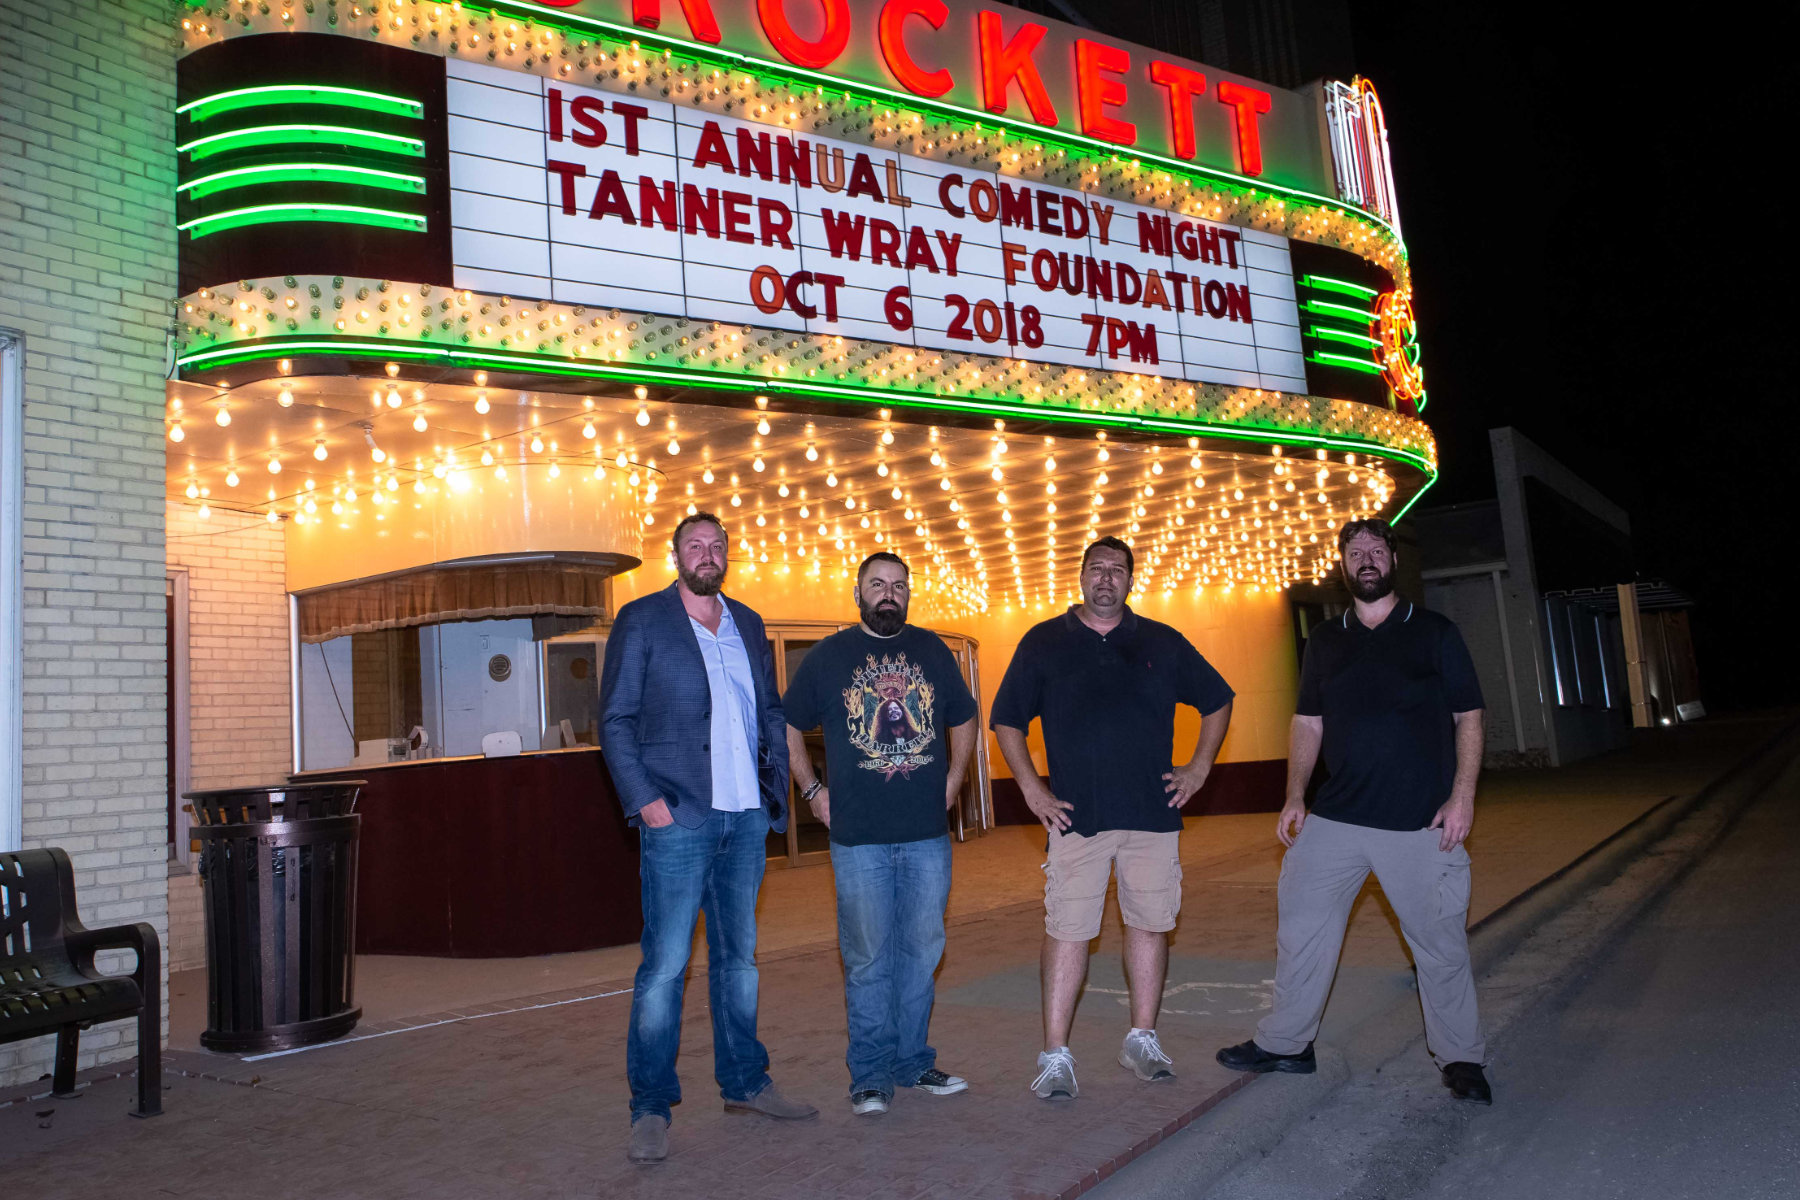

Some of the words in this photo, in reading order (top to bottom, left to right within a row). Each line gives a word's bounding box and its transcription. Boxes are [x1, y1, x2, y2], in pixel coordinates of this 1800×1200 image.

[532, 0, 1273, 177] OCKETT
[547, 159, 795, 250] TANNER
[820, 207, 962, 277] WRAY
[1002, 241, 1253, 325] FOUNDATION
[693, 120, 912, 208] ANNUAL
[938, 173, 1115, 246] COMEDY
[1137, 211, 1241, 270] NIGHT
[749, 264, 846, 323] OCT
[884, 286, 914, 332] 6
[944, 293, 1045, 349] 2018
[1081, 313, 1160, 366] 7PM
